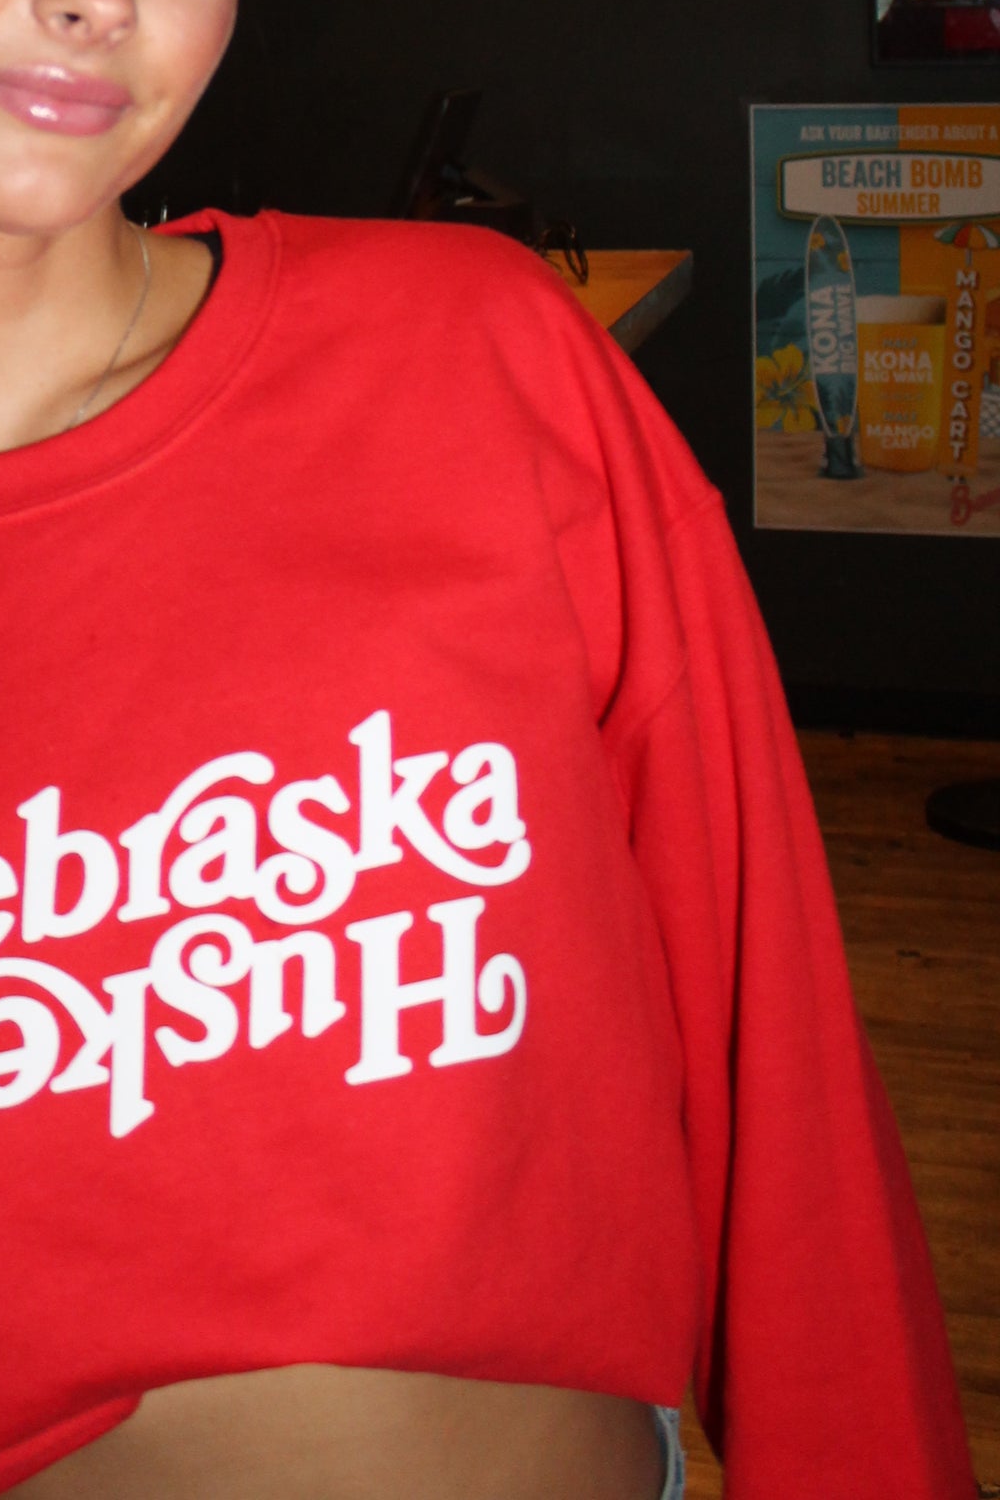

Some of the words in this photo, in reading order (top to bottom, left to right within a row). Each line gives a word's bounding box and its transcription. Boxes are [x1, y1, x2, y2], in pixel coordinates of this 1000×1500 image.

[829, 124, 862, 141] YOUR
[943, 124, 986, 141] ABOUT
[821, 159, 902, 188] BEACH
[911, 159, 983, 188] BOMB
[856, 192, 940, 215] SUMMER
[811, 285, 838, 374] KONA
[951, 269, 978, 371] MANGO
[863, 350, 933, 371] KONA
[866, 424, 935, 439] MANGO
[949, 381, 972, 460] CART
